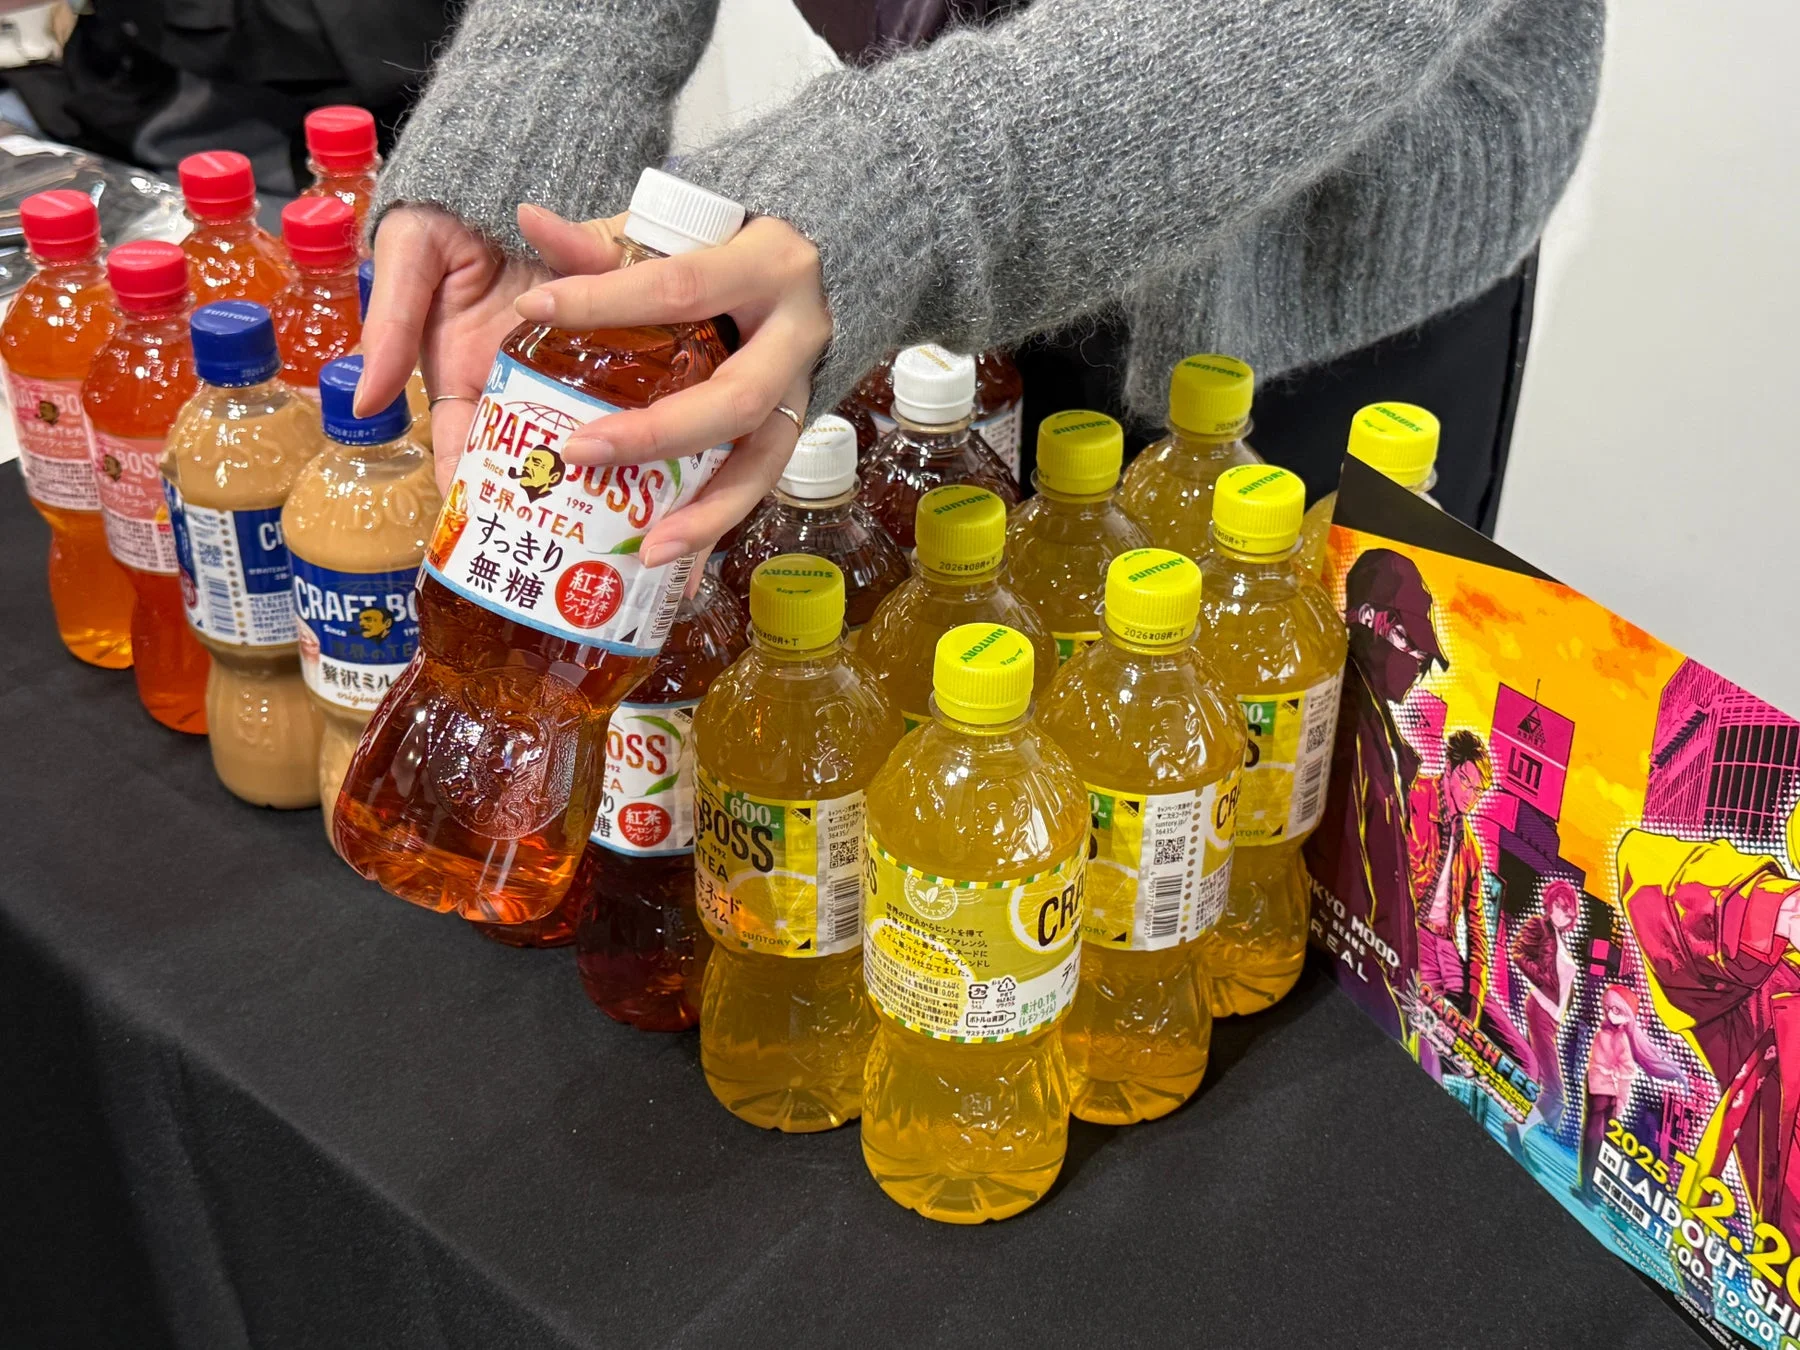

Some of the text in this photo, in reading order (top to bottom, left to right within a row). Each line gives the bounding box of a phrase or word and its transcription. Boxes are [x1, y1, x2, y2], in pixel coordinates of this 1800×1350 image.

[204, 309, 258, 322] SUNTORY
[1185, 361, 1243, 378] SUNTORY
[1052, 419, 1112, 435] SUNTORY
[466, 395, 664, 529] CRAFT OSS
[482, 457, 505, 477] Since
[1238, 470, 1286, 494] SUNTORY
[478, 478, 585, 546] 世界のTEA
[565, 496, 594, 515] 1992
[933, 494, 991, 515] SUNTORY
[477, 511, 564, 575] すっきり
[465, 552, 546, 611] 無糖
[760, 568, 834, 578] SUNTORY
[1128, 557, 1185, 582] SUNTORY
[568, 568, 619, 600] 紅茶
[294, 575, 377, 622] CRAFT
[564, 590, 610, 615] ウーロン茶
[323, 624, 347, 637] Since
[960, 628, 1008, 662] SUNTORY
[625, 808, 662, 826] 紅茶
[730, 797, 771, 827] 600
[742, 930, 791, 946] SUNTORY
[1311, 918, 1369, 983] REAL
[1351, 916, 1400, 968] MOOD
[1605, 1119, 1672, 1192] 2025.
[1602, 1148, 1617, 1171] in
[1619, 1160, 1744, 1280] LAIDOUT
